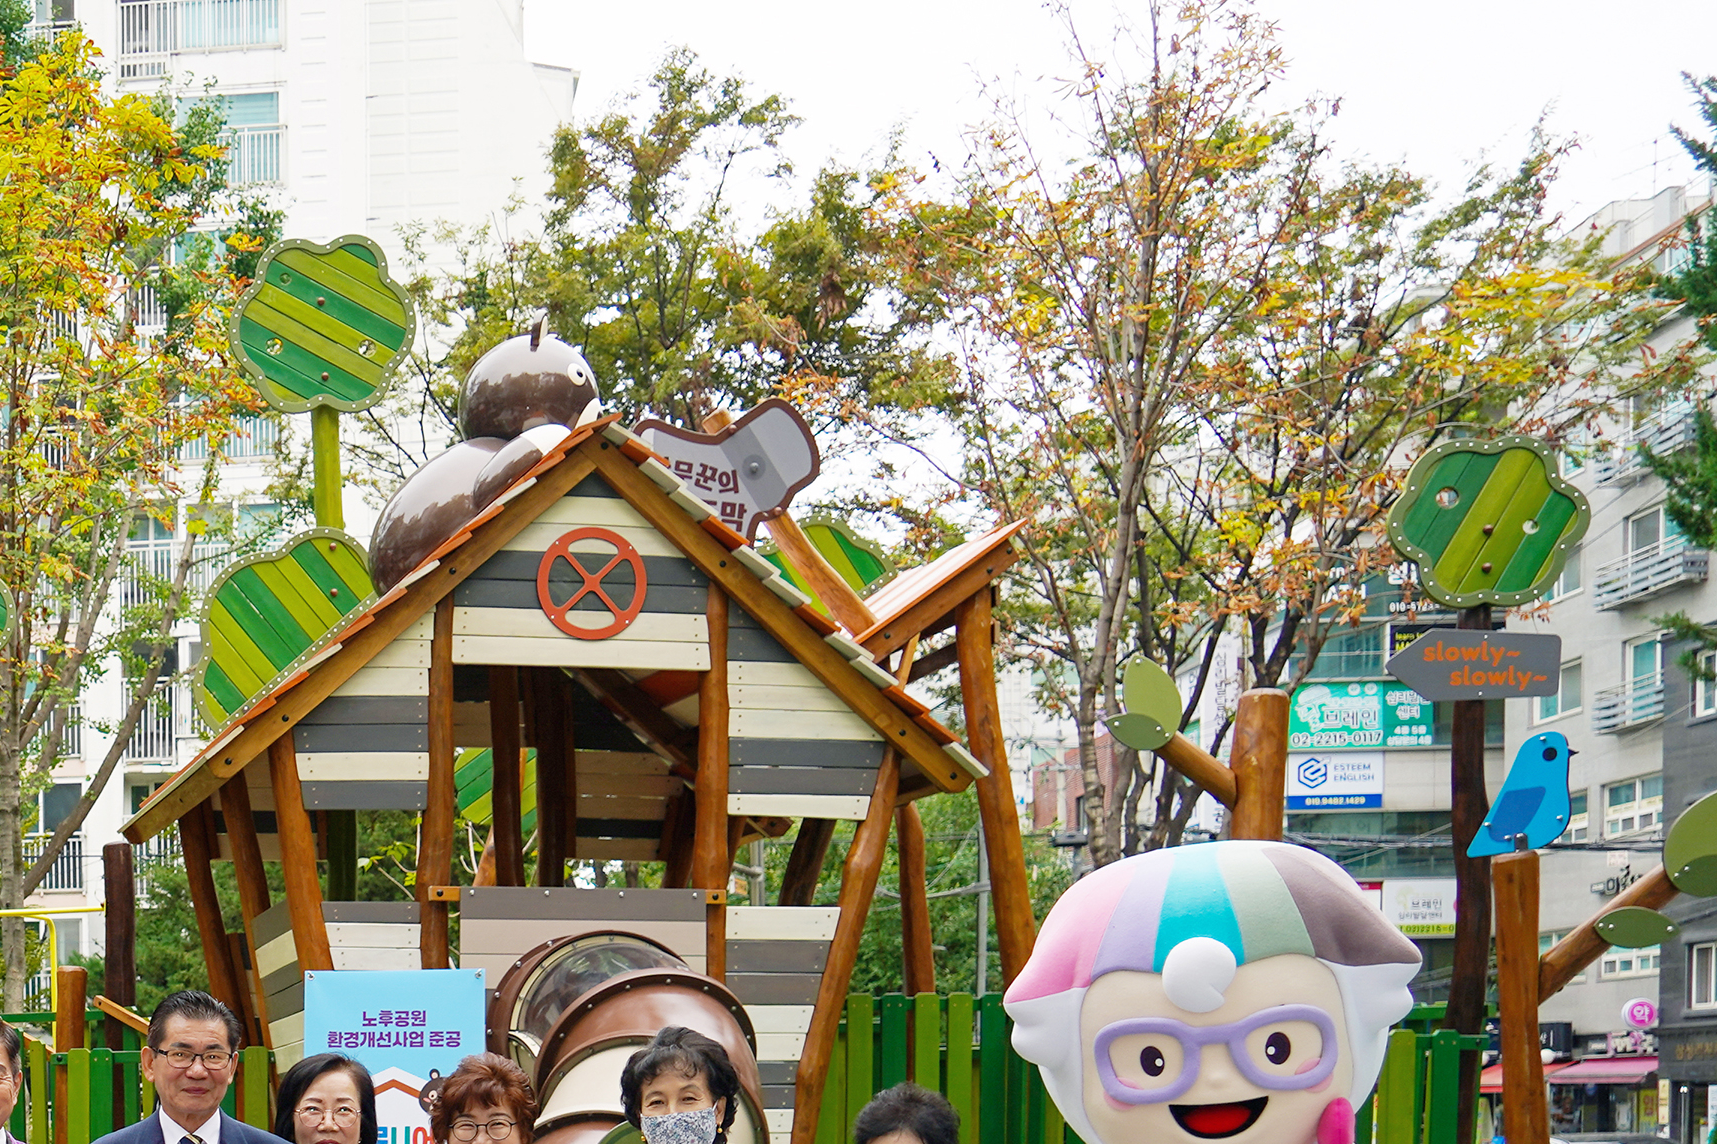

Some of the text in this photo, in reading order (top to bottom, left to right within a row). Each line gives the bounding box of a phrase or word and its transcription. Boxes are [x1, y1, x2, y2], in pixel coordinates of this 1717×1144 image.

[664, 457, 740, 494] 무꾼의
[1422, 640, 1521, 667] slowly~
[1449, 665, 1548, 691] slowly~
[1324, 708, 1379, 729] 브레인
[1396, 705, 1421, 720] 센터
[1291, 731, 1383, 748] 02-2215-0117
[1333, 762, 1371, 772] ESTEEM
[1333, 772, 1375, 782] ENGLISH
[362, 1010, 427, 1028] 노후공원
[327, 1030, 461, 1049] 환경개선사업 준공
